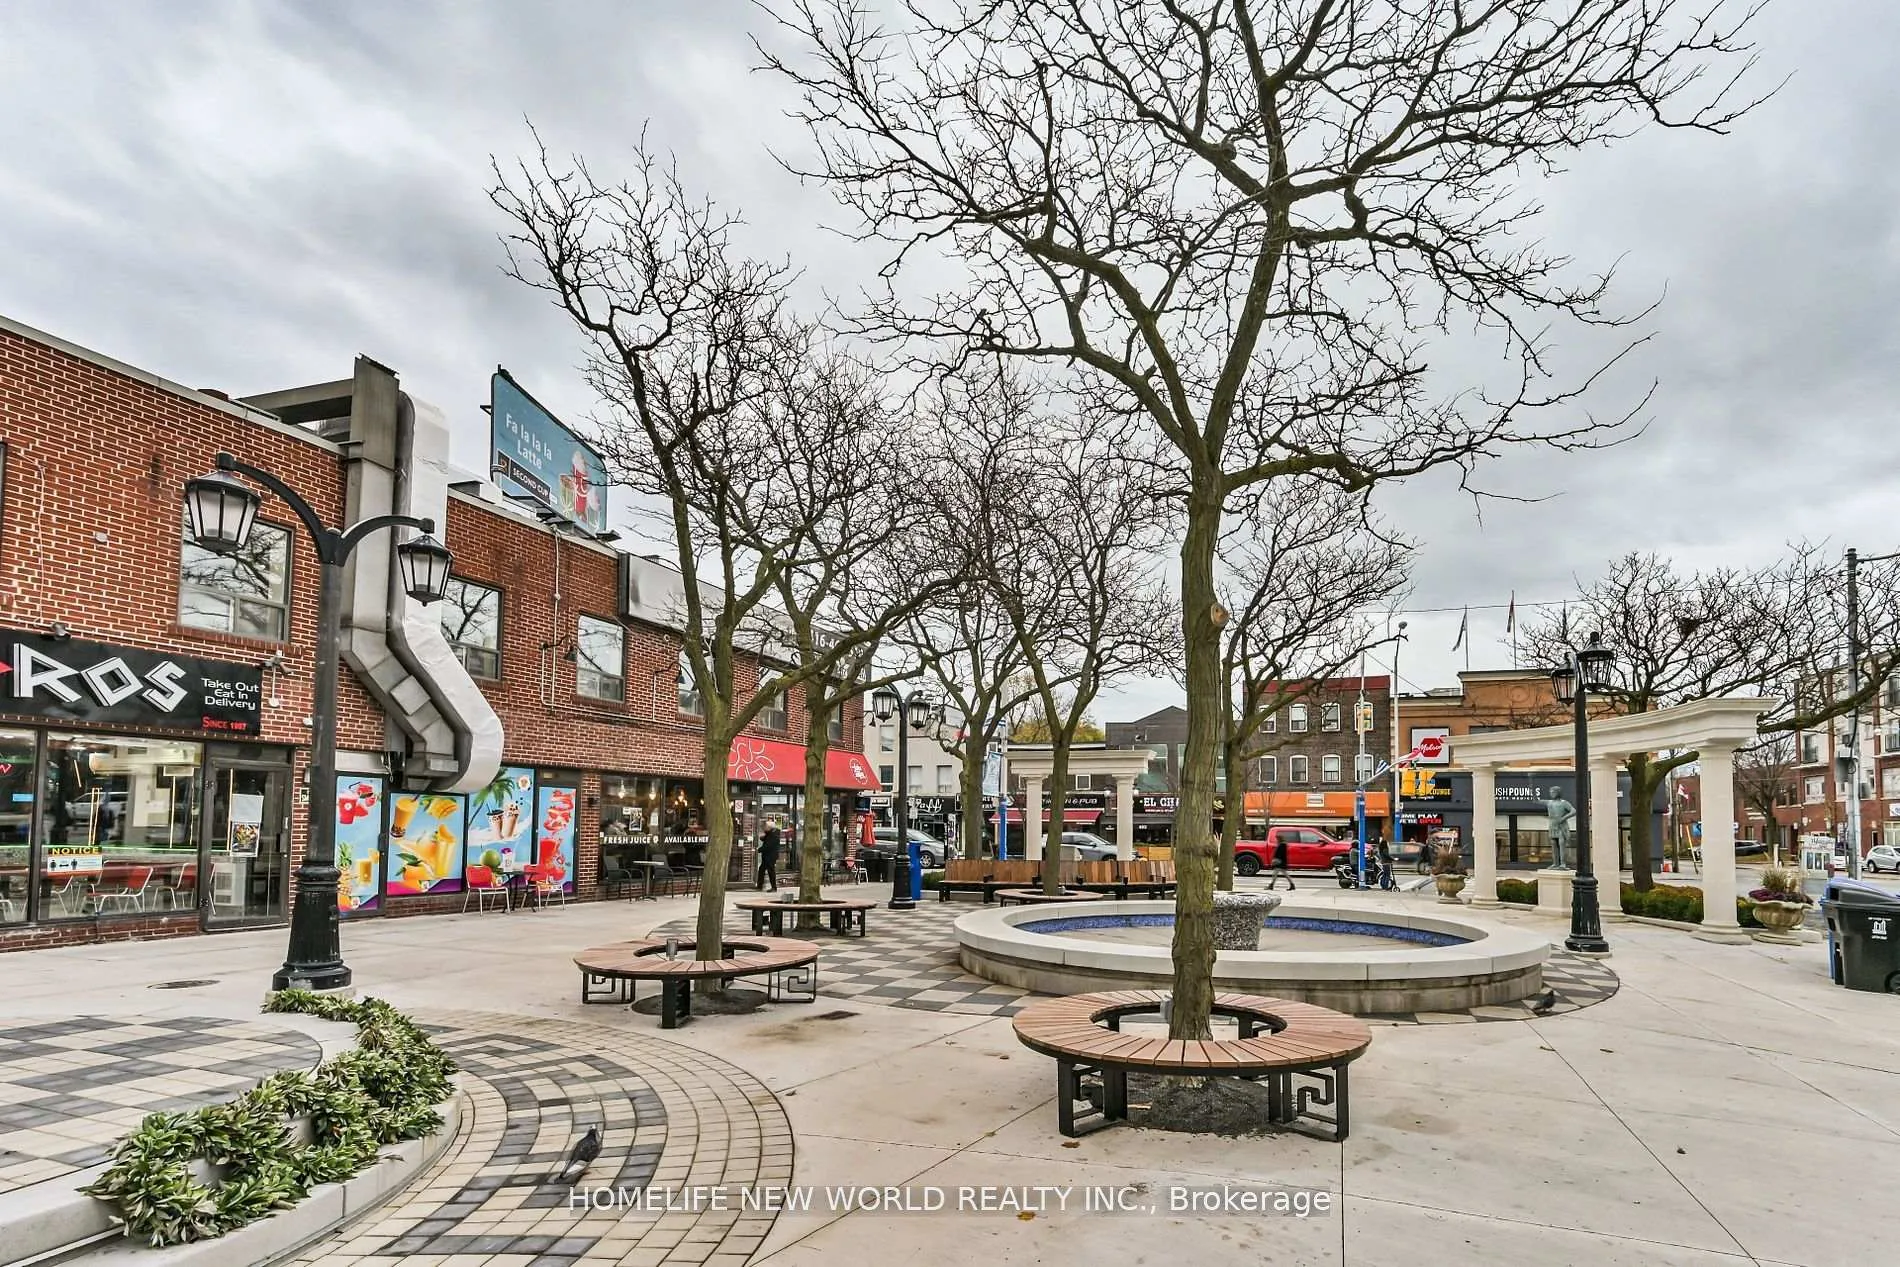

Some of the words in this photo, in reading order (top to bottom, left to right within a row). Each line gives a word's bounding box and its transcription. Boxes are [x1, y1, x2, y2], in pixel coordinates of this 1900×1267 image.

[506, 413, 518, 434] Fa
[521, 424, 530, 443] la
[532, 433, 541, 452] la
[543, 442, 552, 460] la
[517, 439, 542, 470] Latte
[513, 467, 537, 489] SECOND
[200, 677, 231, 690] Take
[235, 682, 260, 693] Out
[214, 688, 236, 699] Eat
[238, 691, 249, 700] In
[204, 695, 256, 711] Delivery
[1144, 797, 1156, 807] EL
[603, 836, 629, 845] FRESH
[630, 836, 651, 845] JUICE
[664, 836, 697, 844] AVAILABLE
[52, 847, 100, 857] NOTICE
